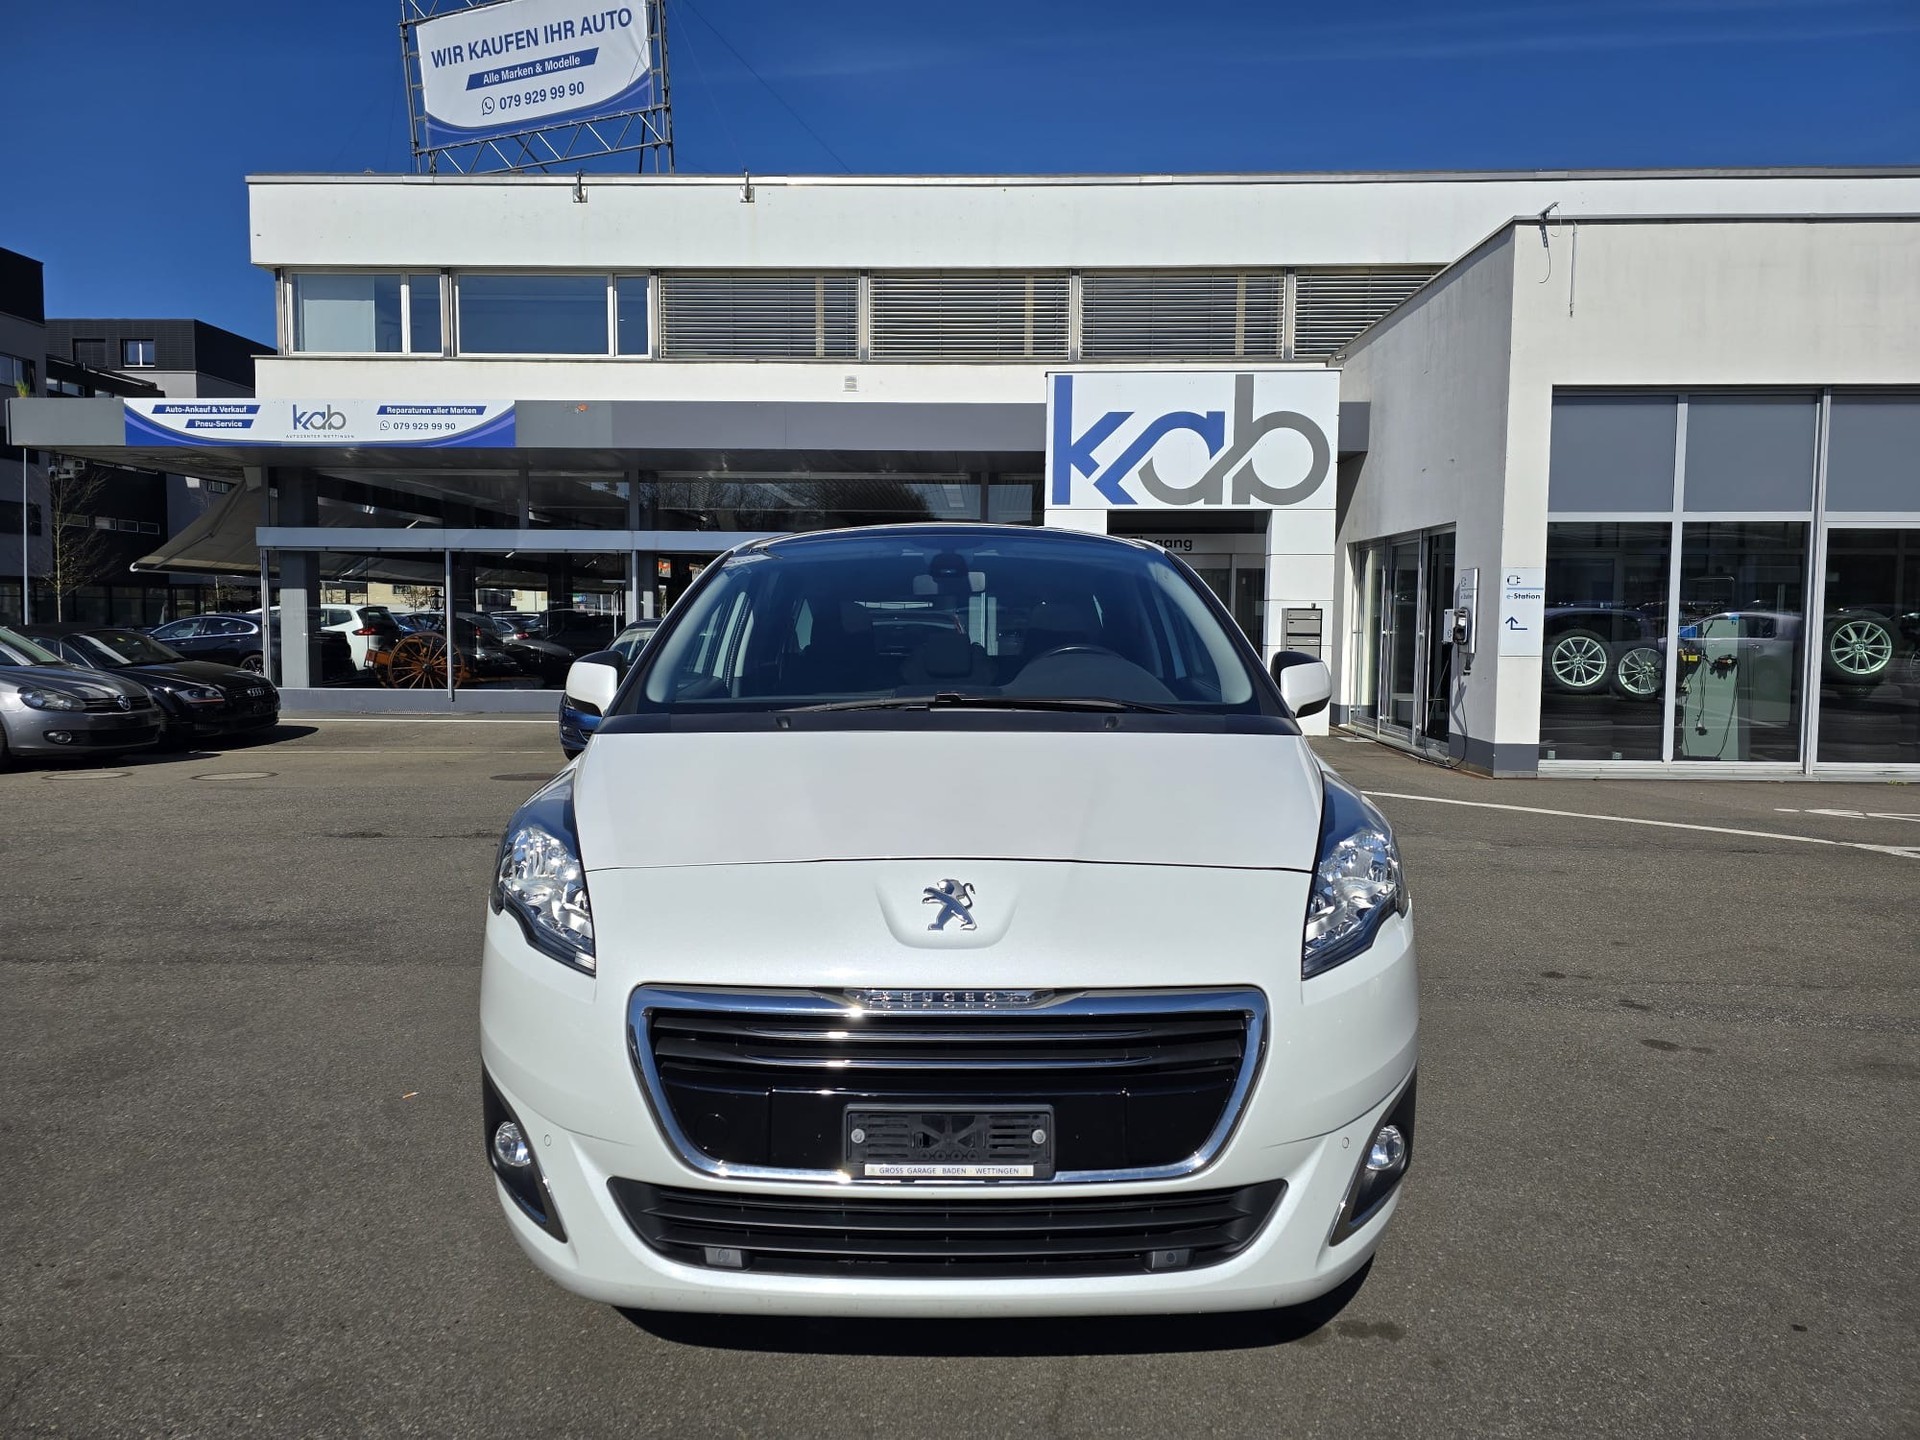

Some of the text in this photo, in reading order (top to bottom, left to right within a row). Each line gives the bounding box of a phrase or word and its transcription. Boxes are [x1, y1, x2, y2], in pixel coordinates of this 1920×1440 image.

[431, 8, 632, 68] WIR KAUFEN IHR AUTO
[483, 55, 580, 85] Alle Marken & Modelle
[500, 81, 584, 110] 079 929 99 90
[165, 405, 211, 413] Auto-Ankauf
[219, 405, 247, 413] Verkauf
[293, 404, 346, 430] kab
[393, 422, 456, 430] 079 929 99 90
[1052, 374, 1331, 505] kab
[1506, 592, 1541, 600] e-Station
[879, 1166, 1019, 1175] GROSS GARAGE BADEN WETTINGEN
